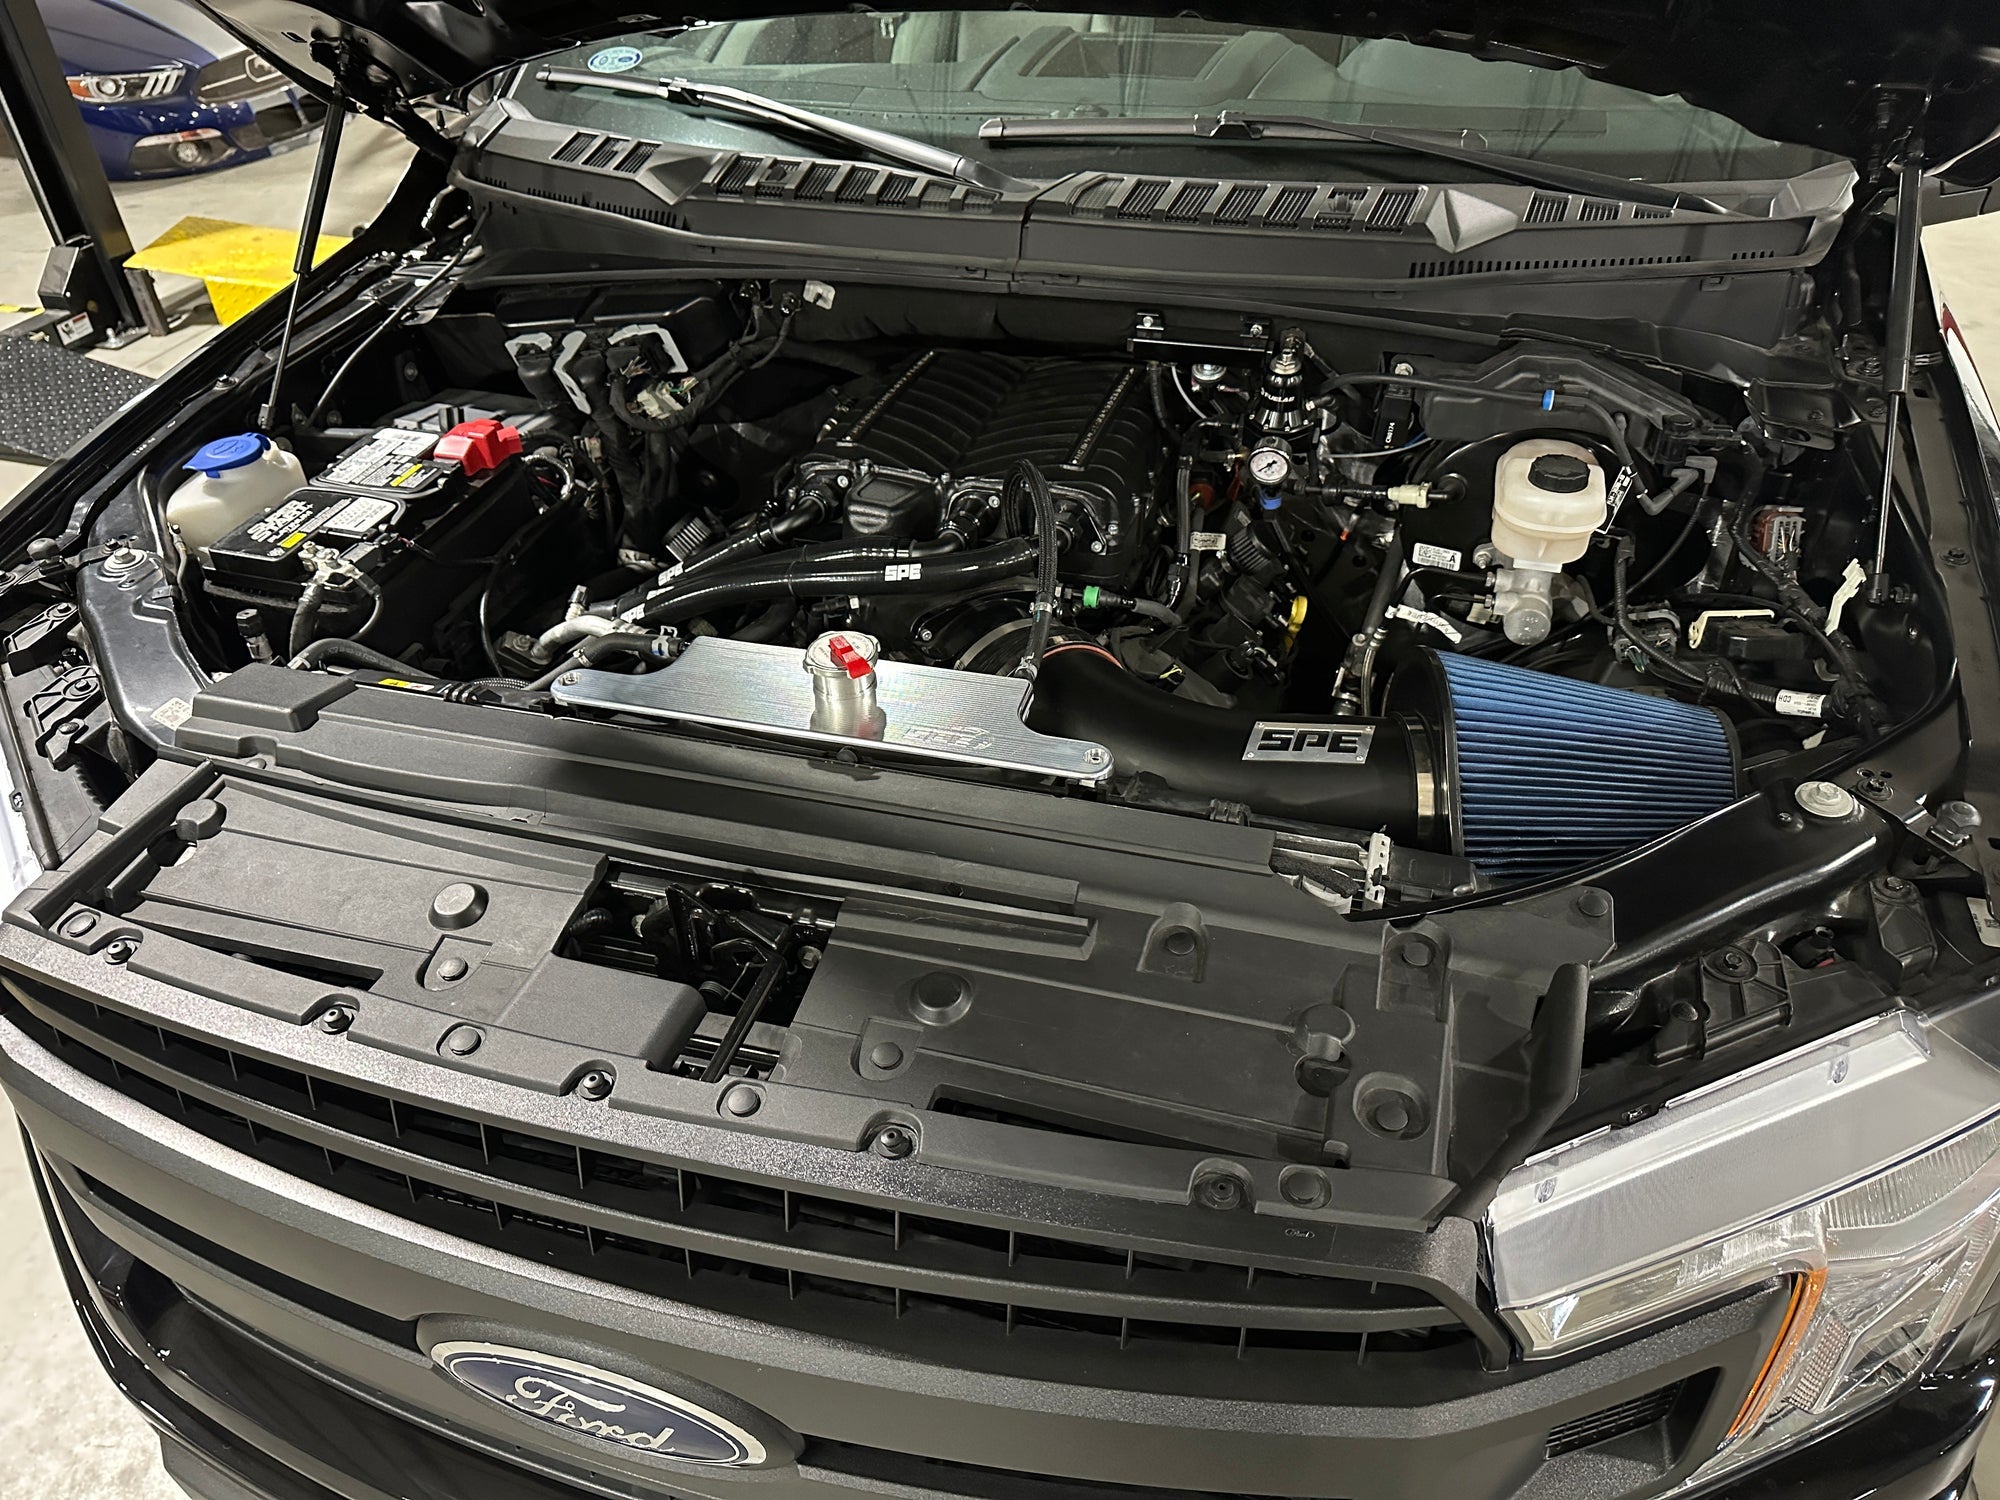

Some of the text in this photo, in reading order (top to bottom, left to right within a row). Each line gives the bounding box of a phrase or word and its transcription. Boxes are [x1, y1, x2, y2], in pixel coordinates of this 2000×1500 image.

[658, 561, 684, 587] SPE
[885, 563, 922, 582] SPE
[1257, 728, 1362, 754] SPE
[505, 1375, 676, 1452] Ford
